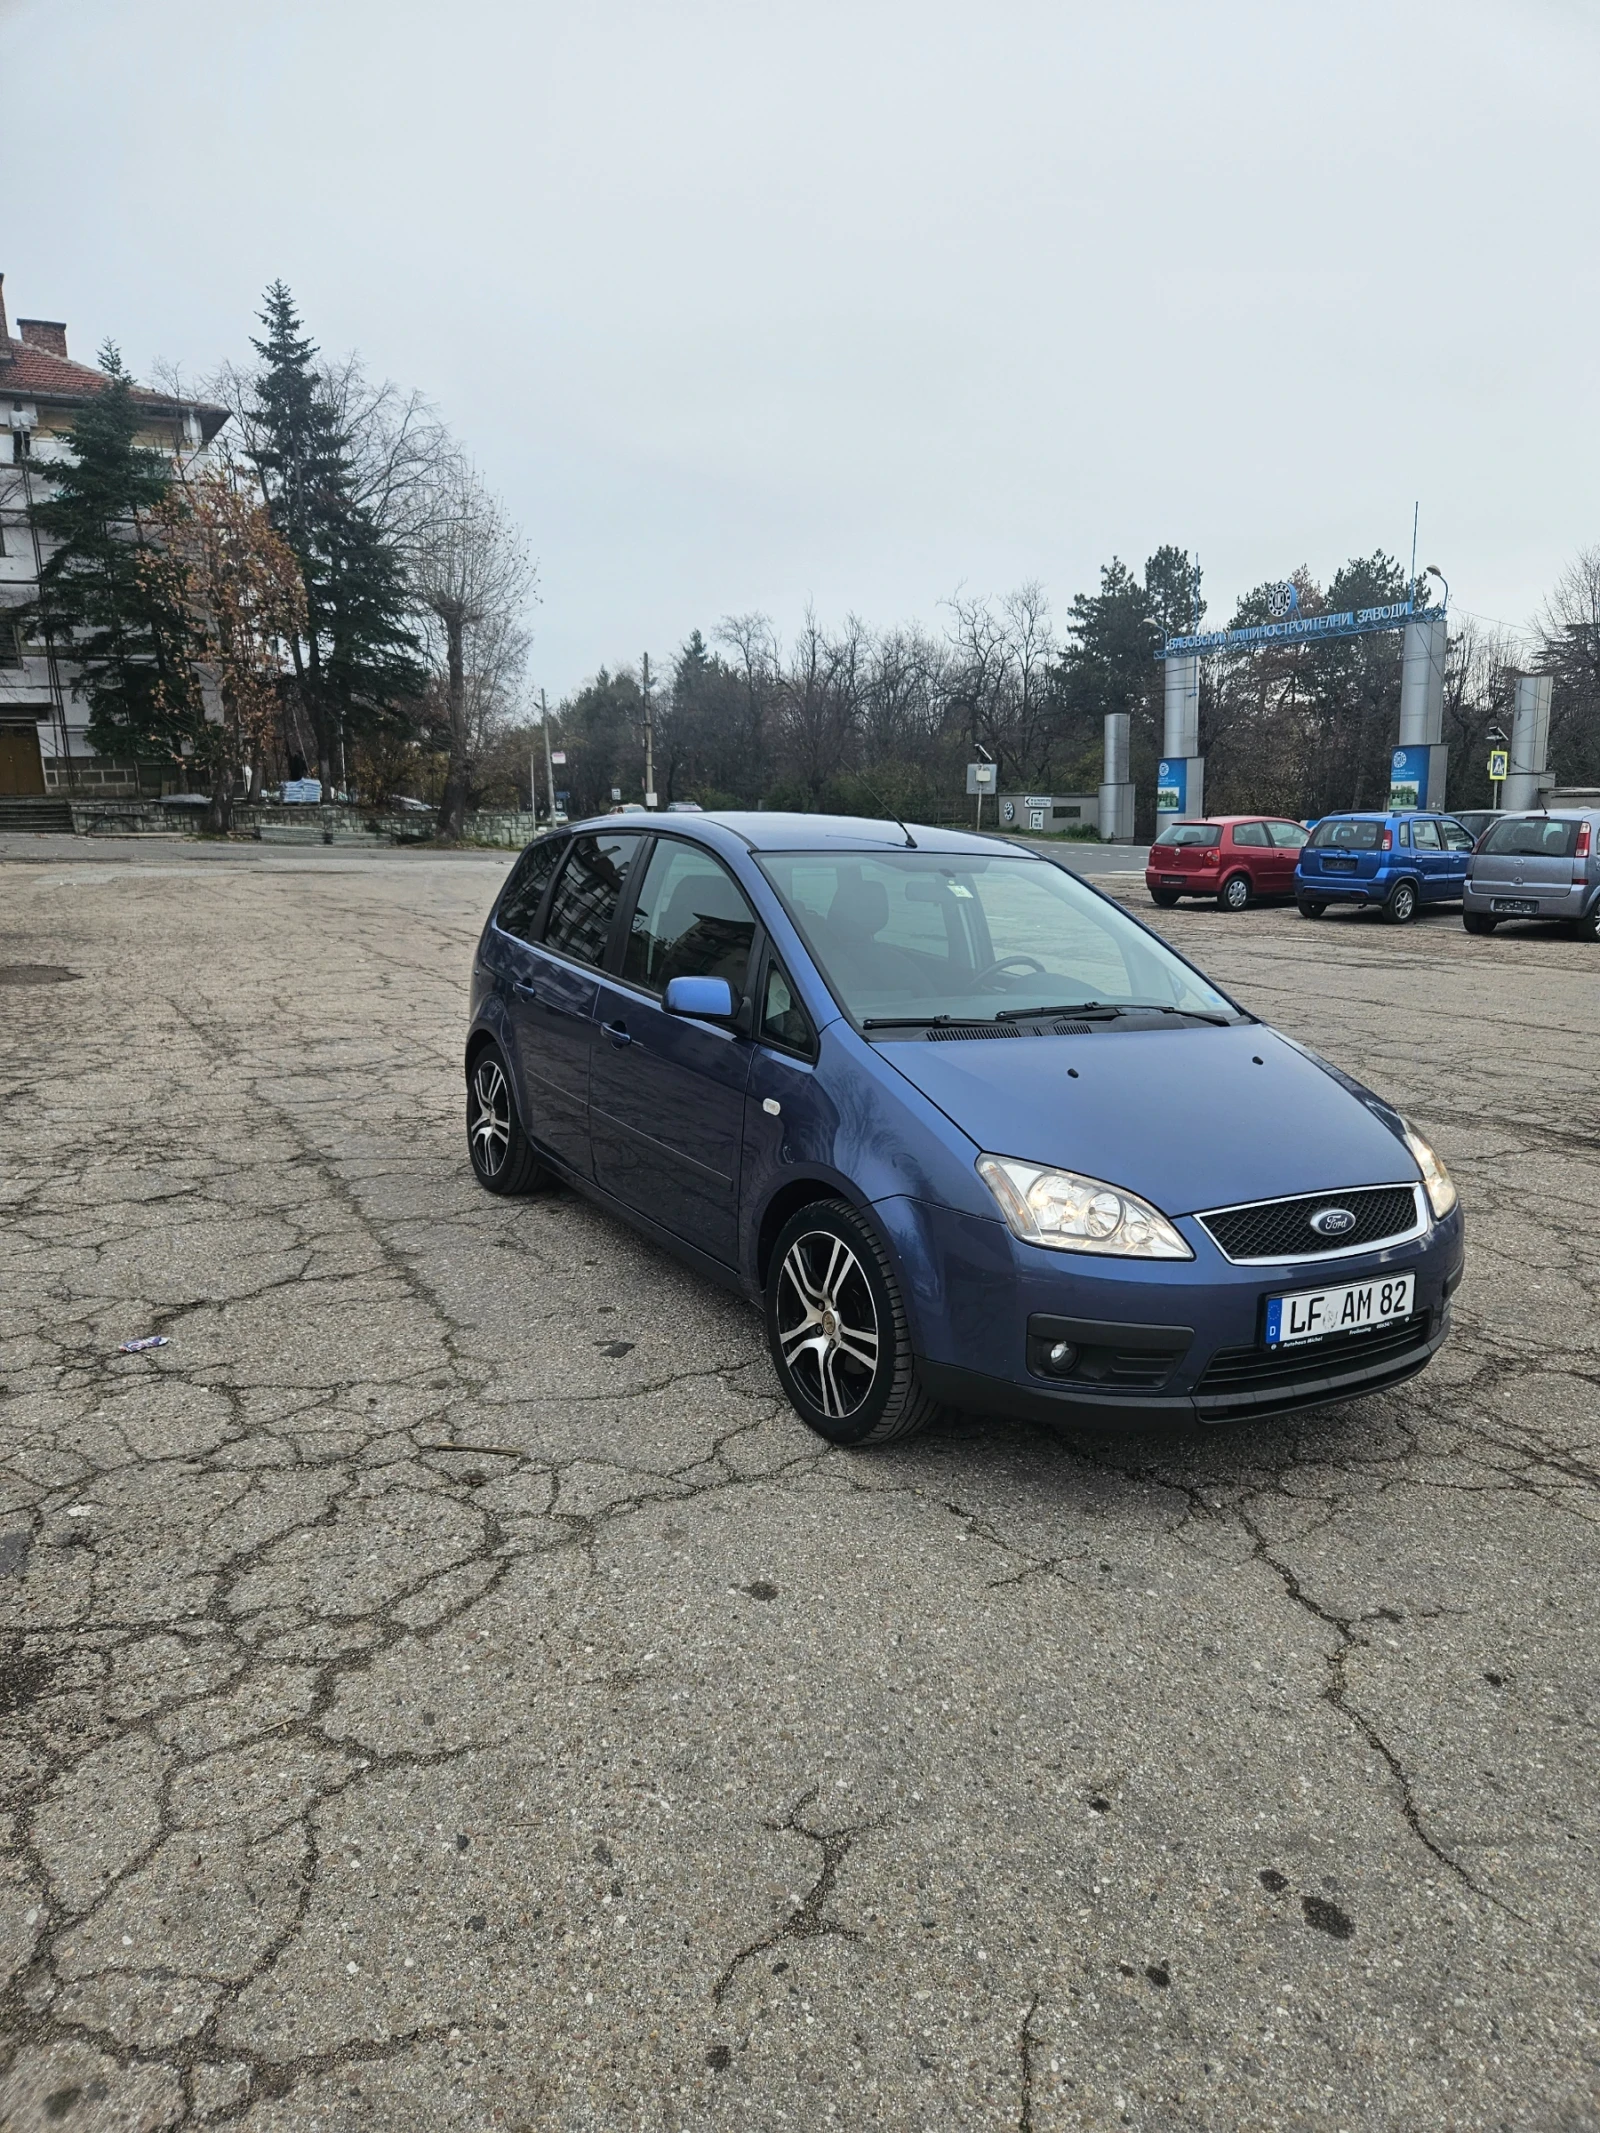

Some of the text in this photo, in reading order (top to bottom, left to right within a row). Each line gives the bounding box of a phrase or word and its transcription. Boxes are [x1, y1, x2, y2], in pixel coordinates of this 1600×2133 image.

[1169, 602, 1409, 650] ВАЗОВСКИ МАШИНОСТРОИТЕЛНИ ЗАВОДИ
[1325, 1215, 1347, 1230] Ford
[1290, 1280, 1407, 1334] LF AM 82
[1269, 1325, 1276, 1336] D
[1282, 1339, 1307, 1348] Autohaus
